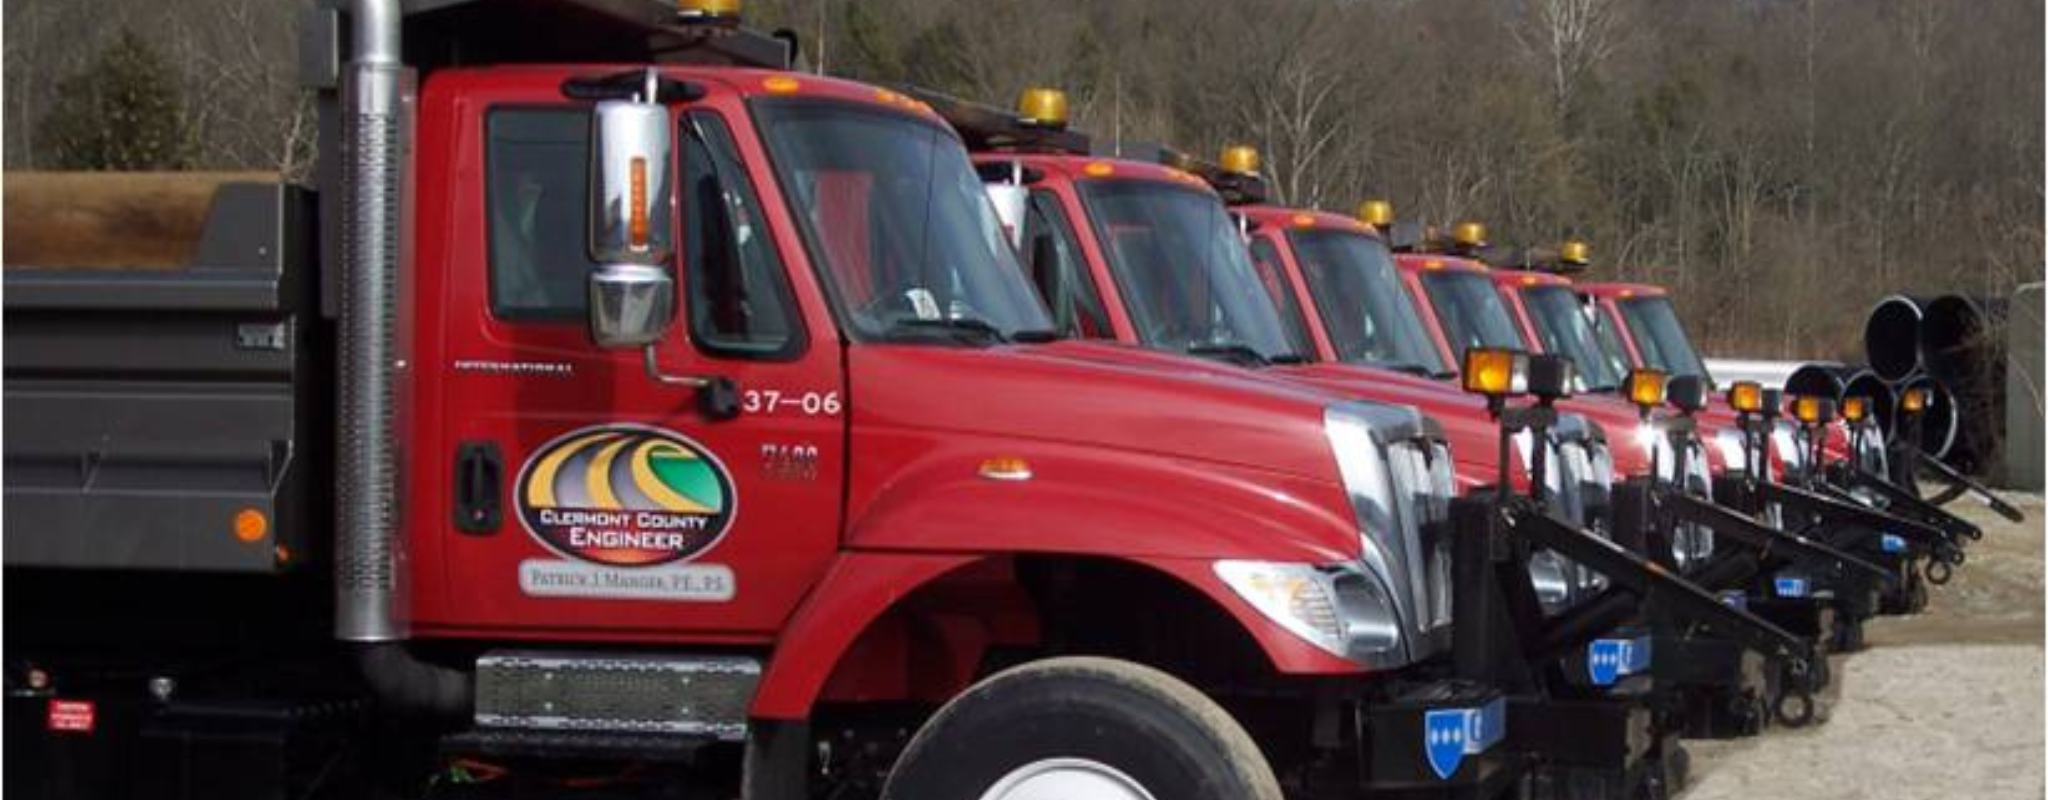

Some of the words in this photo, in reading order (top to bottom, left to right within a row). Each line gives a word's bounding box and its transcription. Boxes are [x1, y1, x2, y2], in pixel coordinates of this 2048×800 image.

[743, 389, 842, 415] 37-06
[540, 509, 631, 527] CLERMONT
[637, 511, 708, 530] COUNTY
[569, 527, 685, 549] ENGINEER
